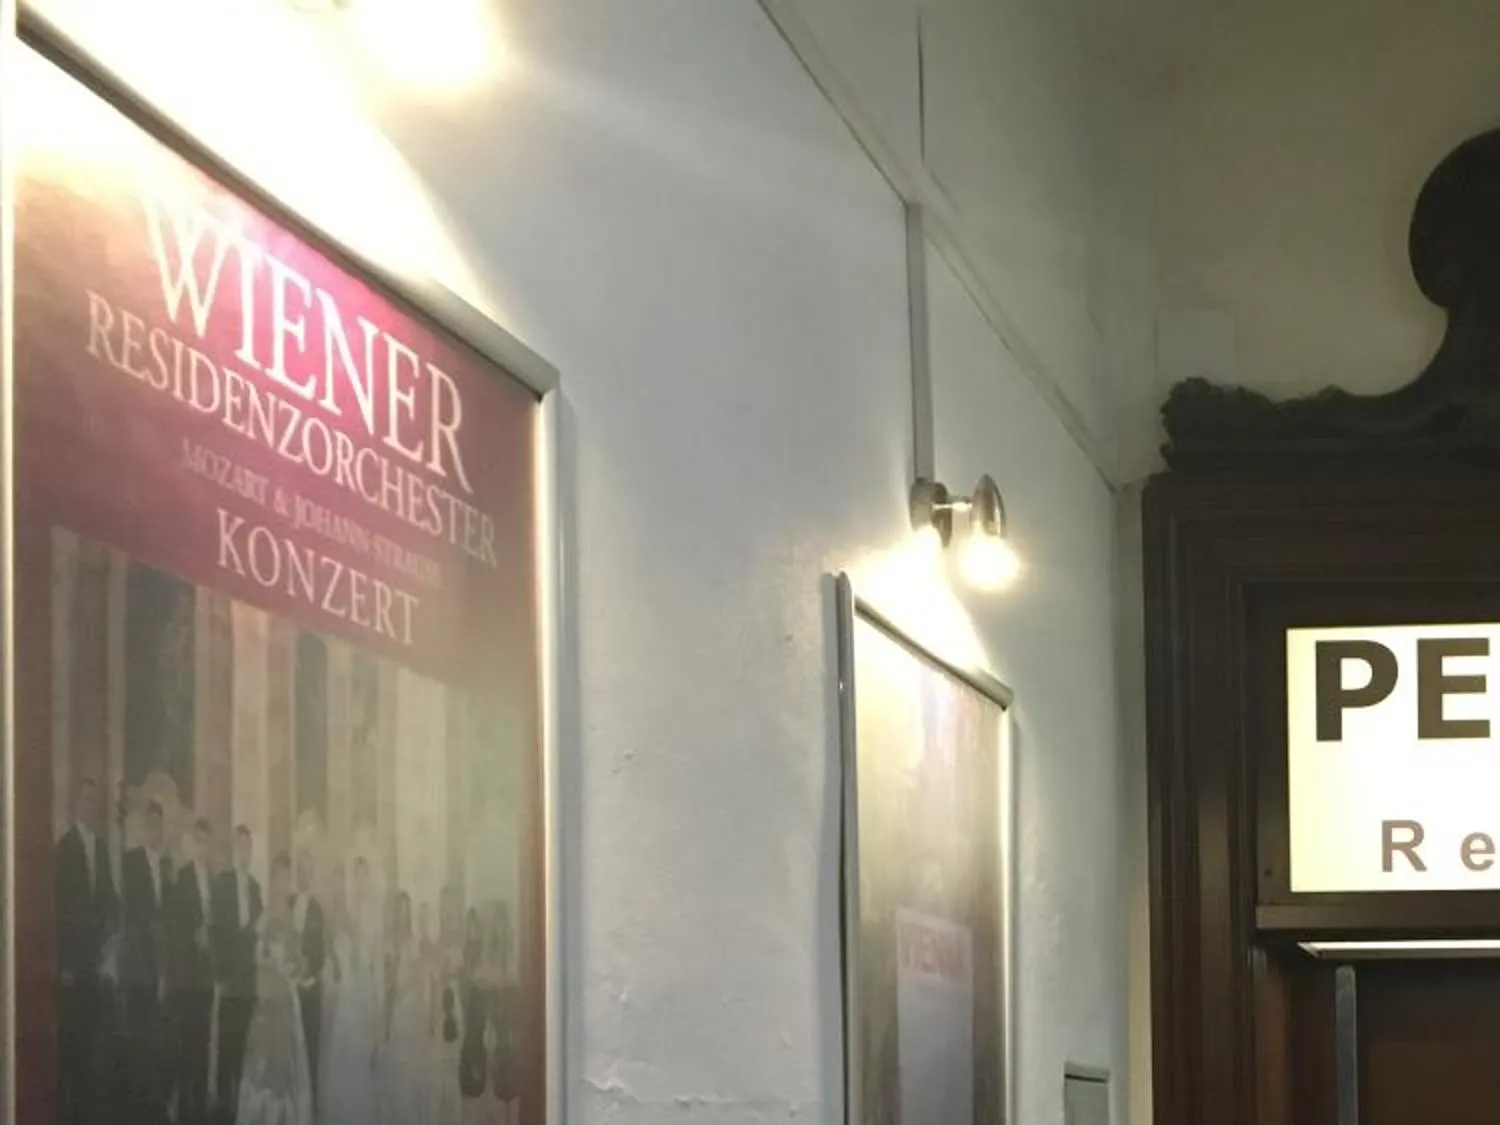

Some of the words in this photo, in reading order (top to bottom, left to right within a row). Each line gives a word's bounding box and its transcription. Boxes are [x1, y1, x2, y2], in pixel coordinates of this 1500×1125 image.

[85, 289, 497, 569] RESIDENZORCHESTER
[145, 196, 473, 494] WIENER
[181, 437, 269, 505] MOZART
[274, 486, 288, 517] &
[216, 508, 418, 646] KONZERT
